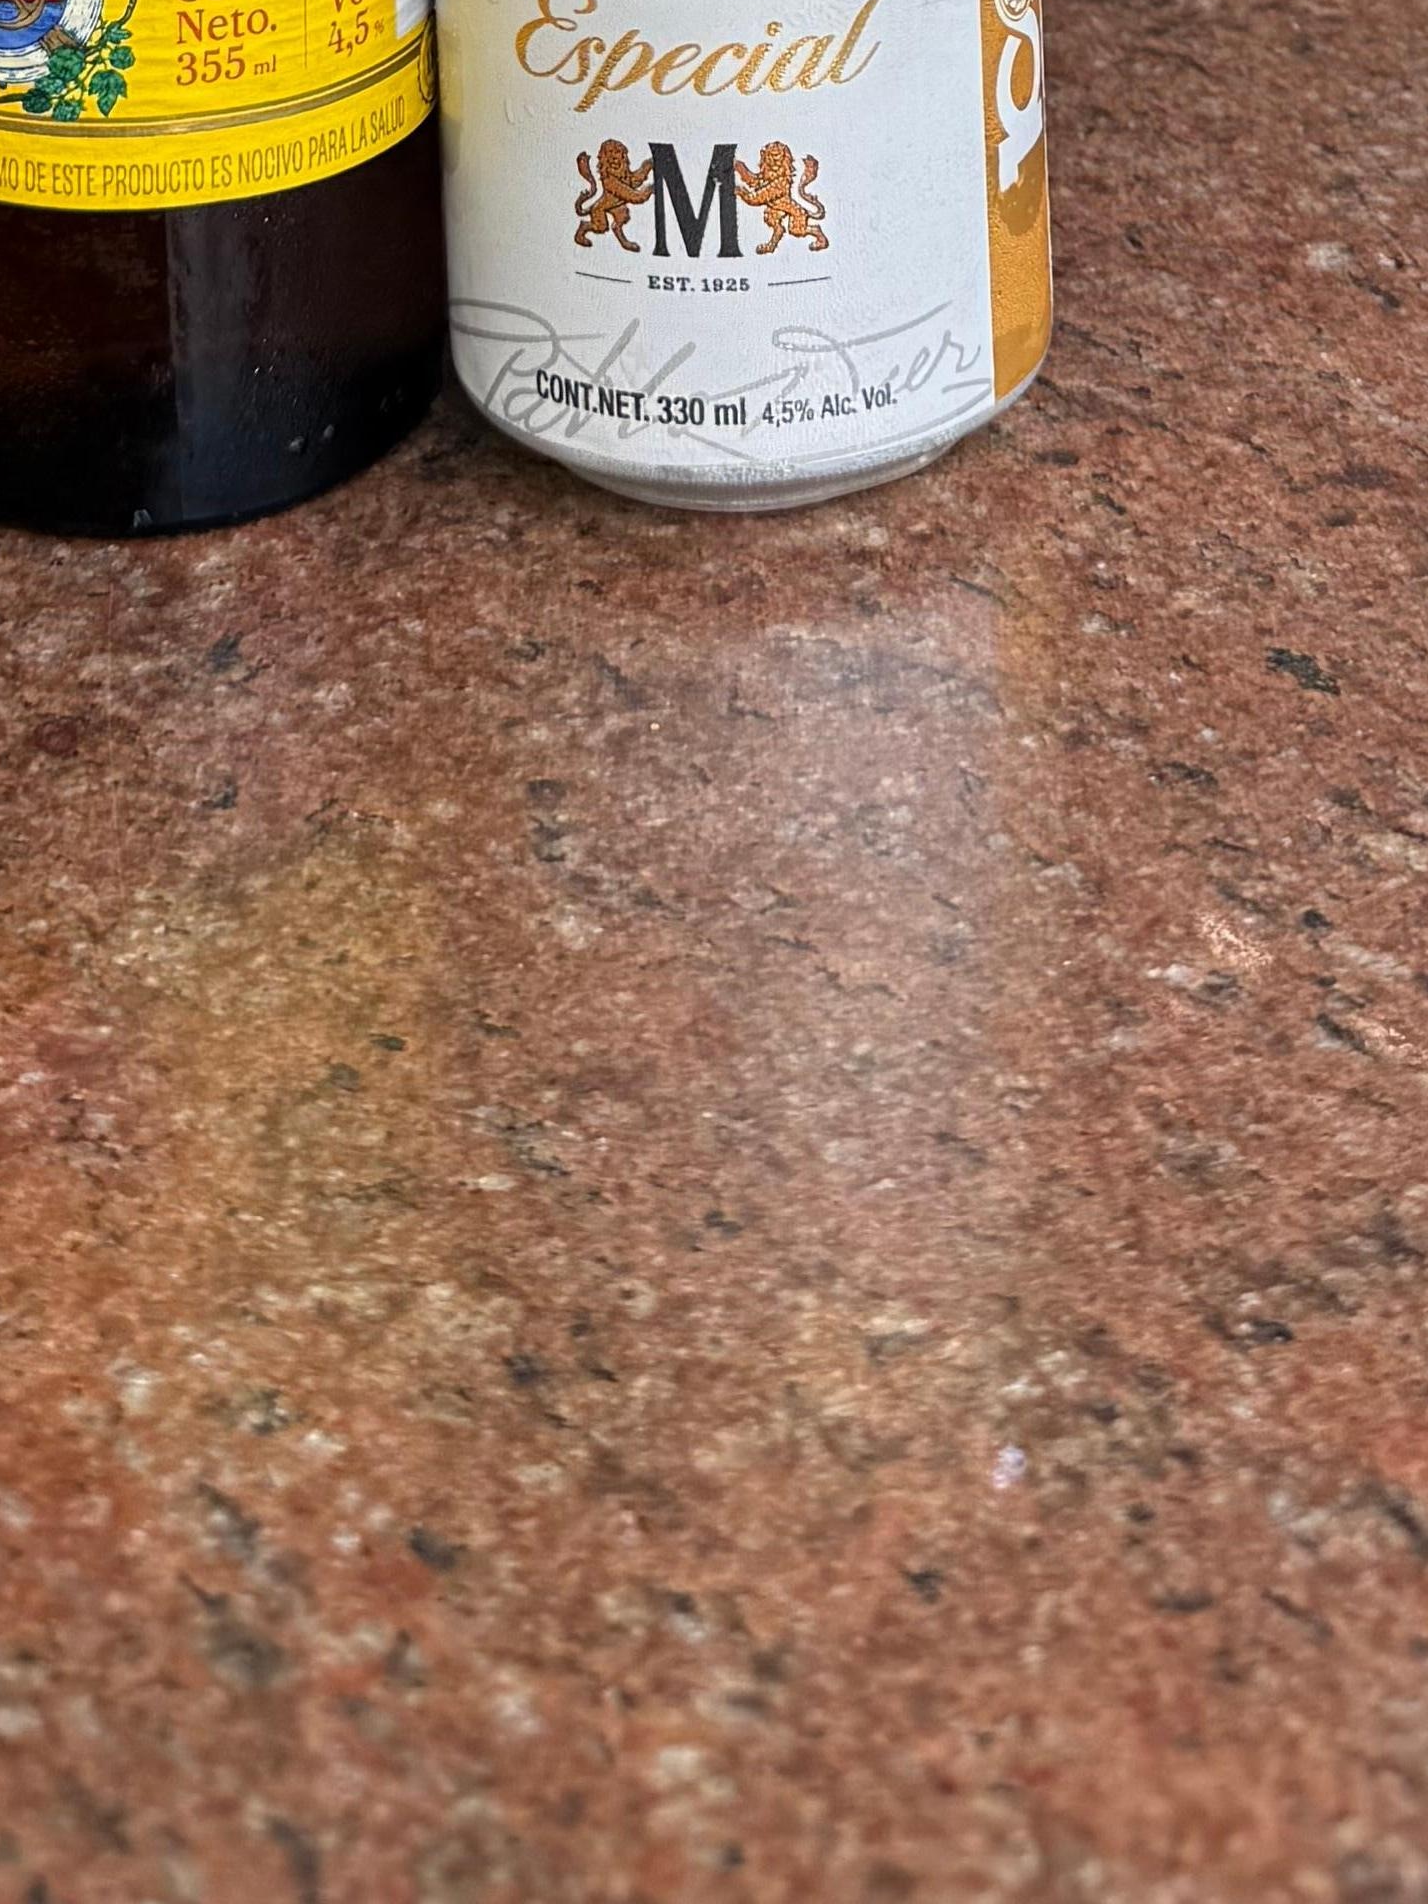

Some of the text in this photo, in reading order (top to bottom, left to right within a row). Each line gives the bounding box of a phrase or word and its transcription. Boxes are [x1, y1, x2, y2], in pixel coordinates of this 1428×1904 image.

[176, 9, 278, 45] Neto.
[176, 45, 278, 86] 355 ml
[26, 160, 47, 194] DE
[52, 163, 97, 197] ESTE
[103, 158, 205, 197] PRODUCTO
[211, 154, 233, 189] ES
[238, 140, 304, 184] NOCIVO
[308, 127, 348, 169] PARA
[351, 116, 369, 154] LA
[370, 94, 406, 145] SALUD
[647, 142, 744, 259] M
[647, 274, 752, 293] EST. 1925
[657, 396, 706, 426] 330
[713, 396, 747, 426] ml
[761, 398, 815, 428] 4,5%
[821, 390, 857, 416] Alc.
[861, 381, 899, 411] Vol.
